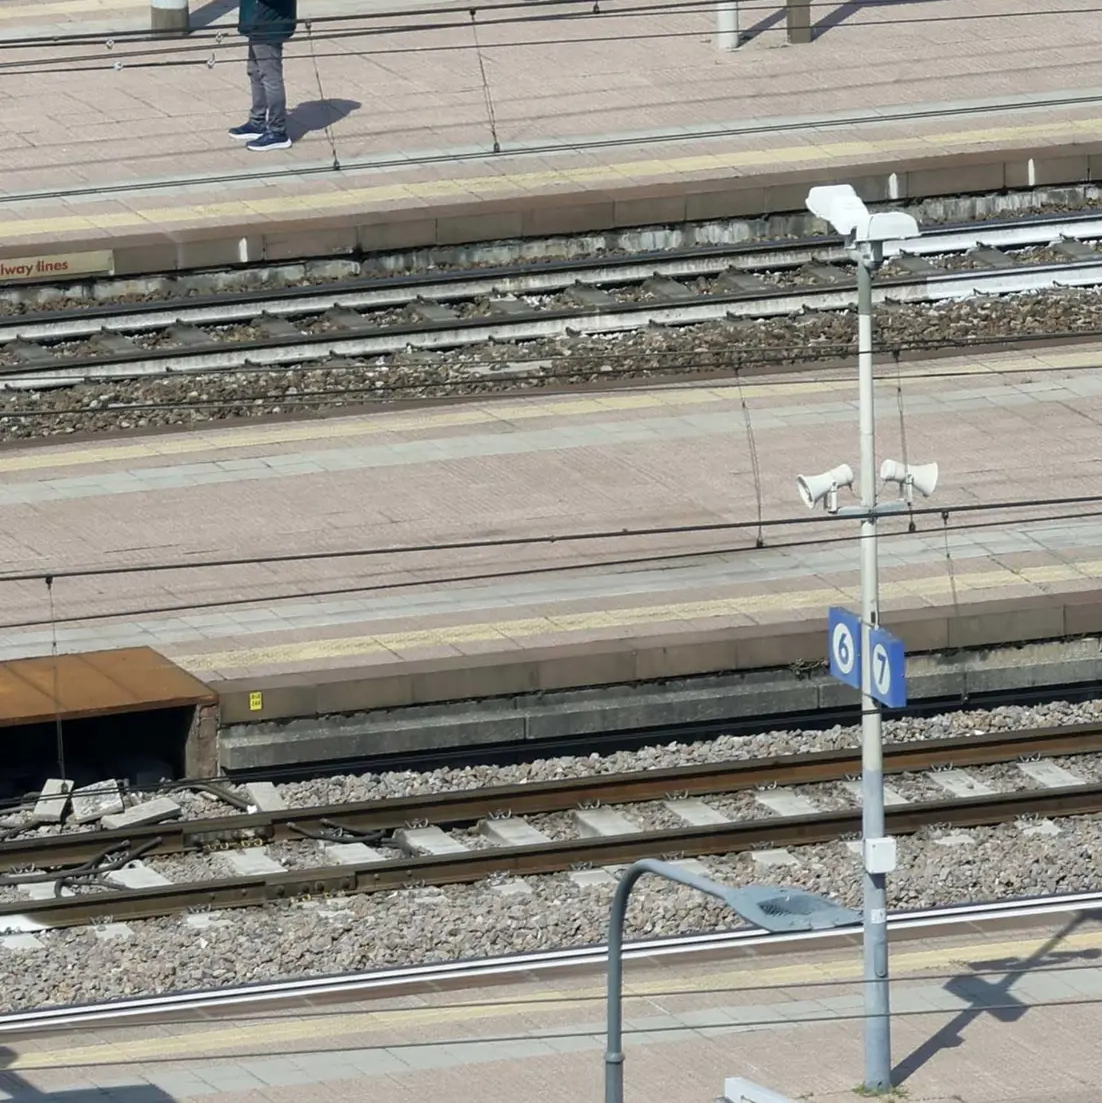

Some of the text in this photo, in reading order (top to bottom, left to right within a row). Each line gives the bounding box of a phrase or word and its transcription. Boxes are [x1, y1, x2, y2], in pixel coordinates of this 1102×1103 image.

[37, 261, 68, 272] lines
[839, 633, 850, 665] 6
[877, 652, 887, 684] 7
